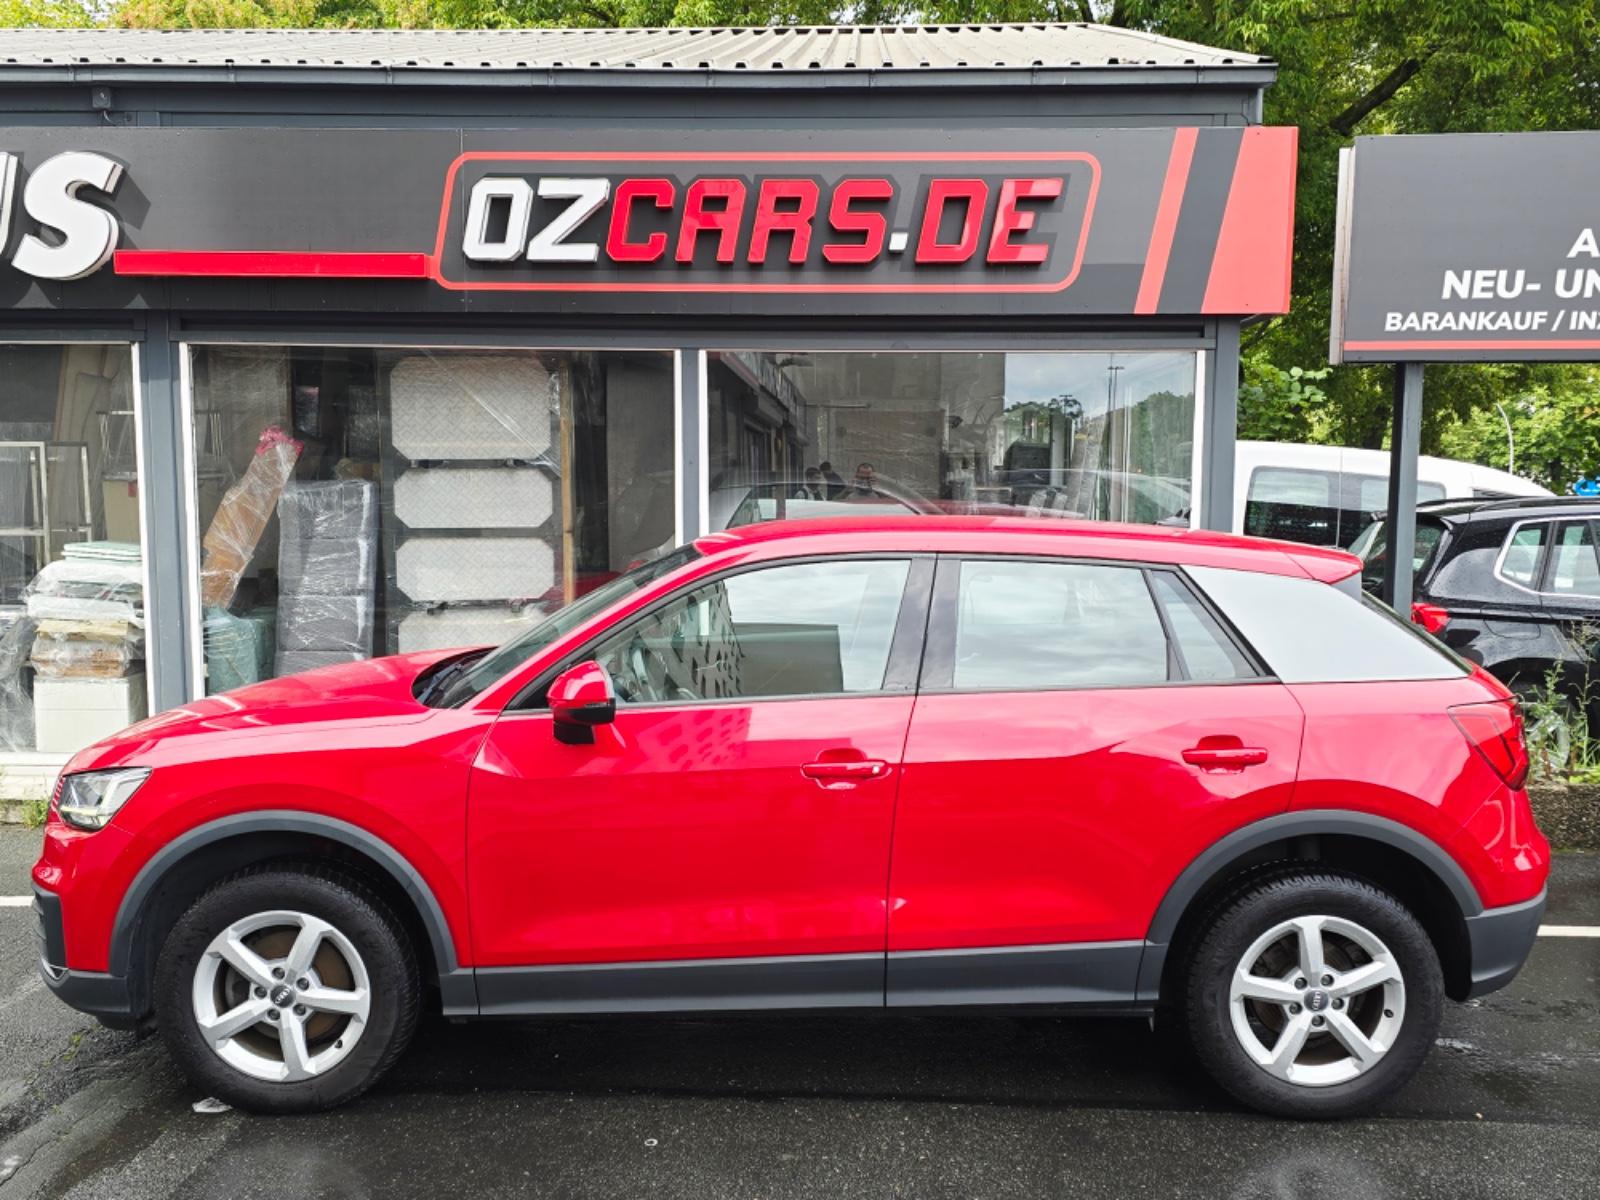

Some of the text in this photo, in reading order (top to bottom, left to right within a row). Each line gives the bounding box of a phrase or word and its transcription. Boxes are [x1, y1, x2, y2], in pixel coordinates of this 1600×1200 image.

[462, 177, 1064, 265] OZCARS.DE
[1441, 269, 1541, 299] NEU-
[1384, 309, 1600, 332] BARANKAUF / IN
